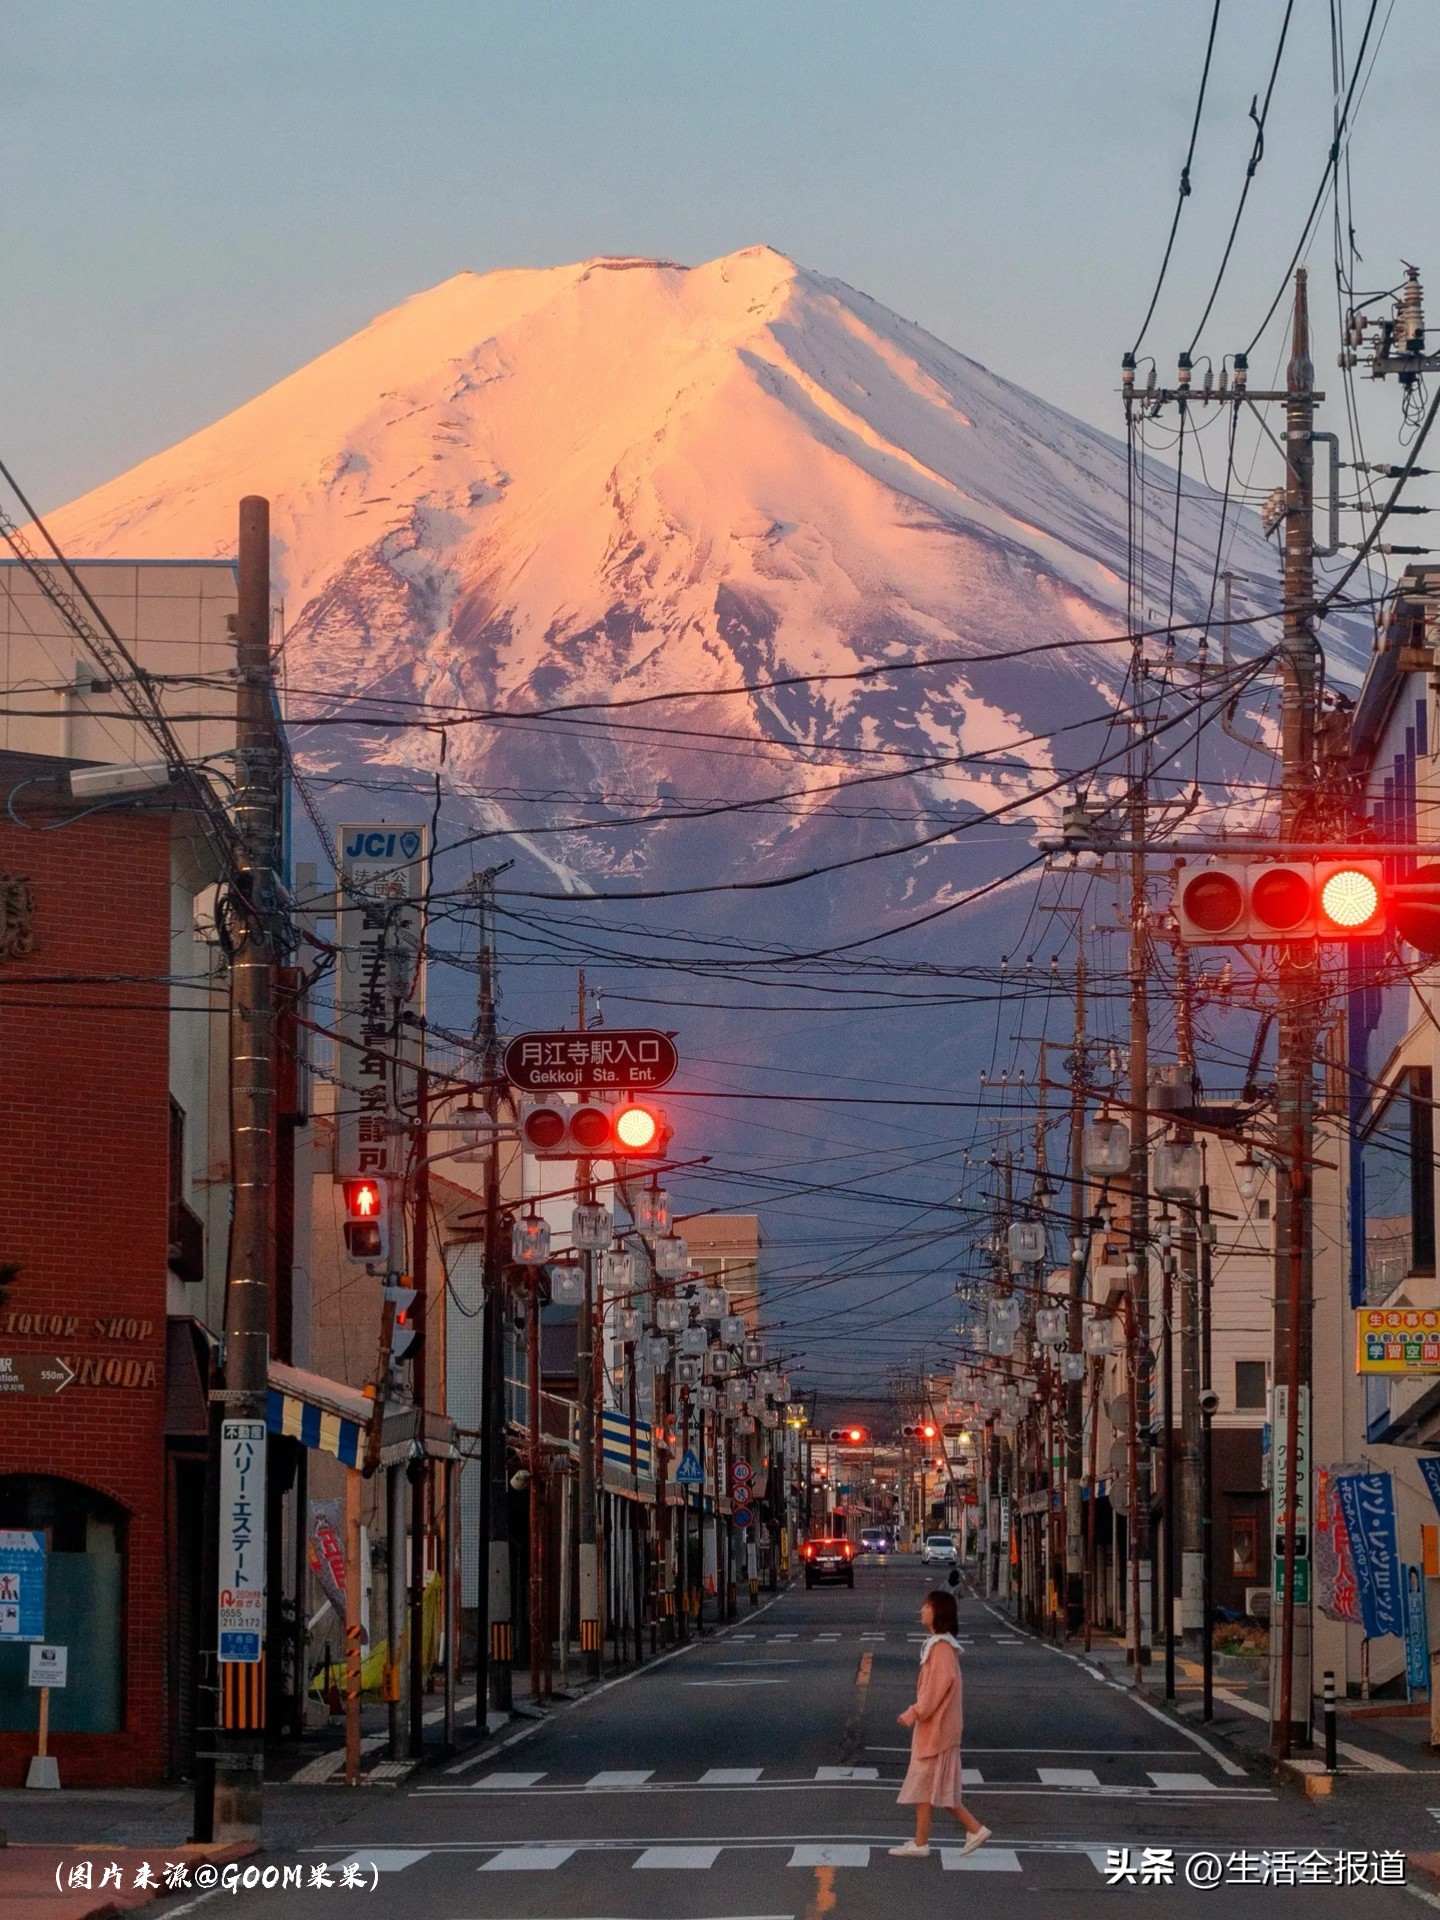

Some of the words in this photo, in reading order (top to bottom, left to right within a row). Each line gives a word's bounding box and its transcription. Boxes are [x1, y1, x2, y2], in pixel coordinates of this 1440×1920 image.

[346, 833, 396, 857] JCI
[521, 1040, 660, 1067] 月江寺駅入口
[529, 1069, 583, 1085] Gekkoji
[592, 1068, 620, 1082] Sta.
[629, 1067, 657, 1081] Ent.
[0, 1312, 80, 1337] IQUOR
[93, 1317, 154, 1340] SHOP
[1369, 1313, 1437, 1326] 生徒募集
[1368, 1344, 1439, 1359] 学習空間
[0, 1373, 19, 1383] tion
[41, 1370, 65, 1380] 550m
[225, 1426, 262, 1439] 不動産
[232, 1442, 253, 1588] ハリー・エステート
[220, 1609, 242, 1617] 0555
